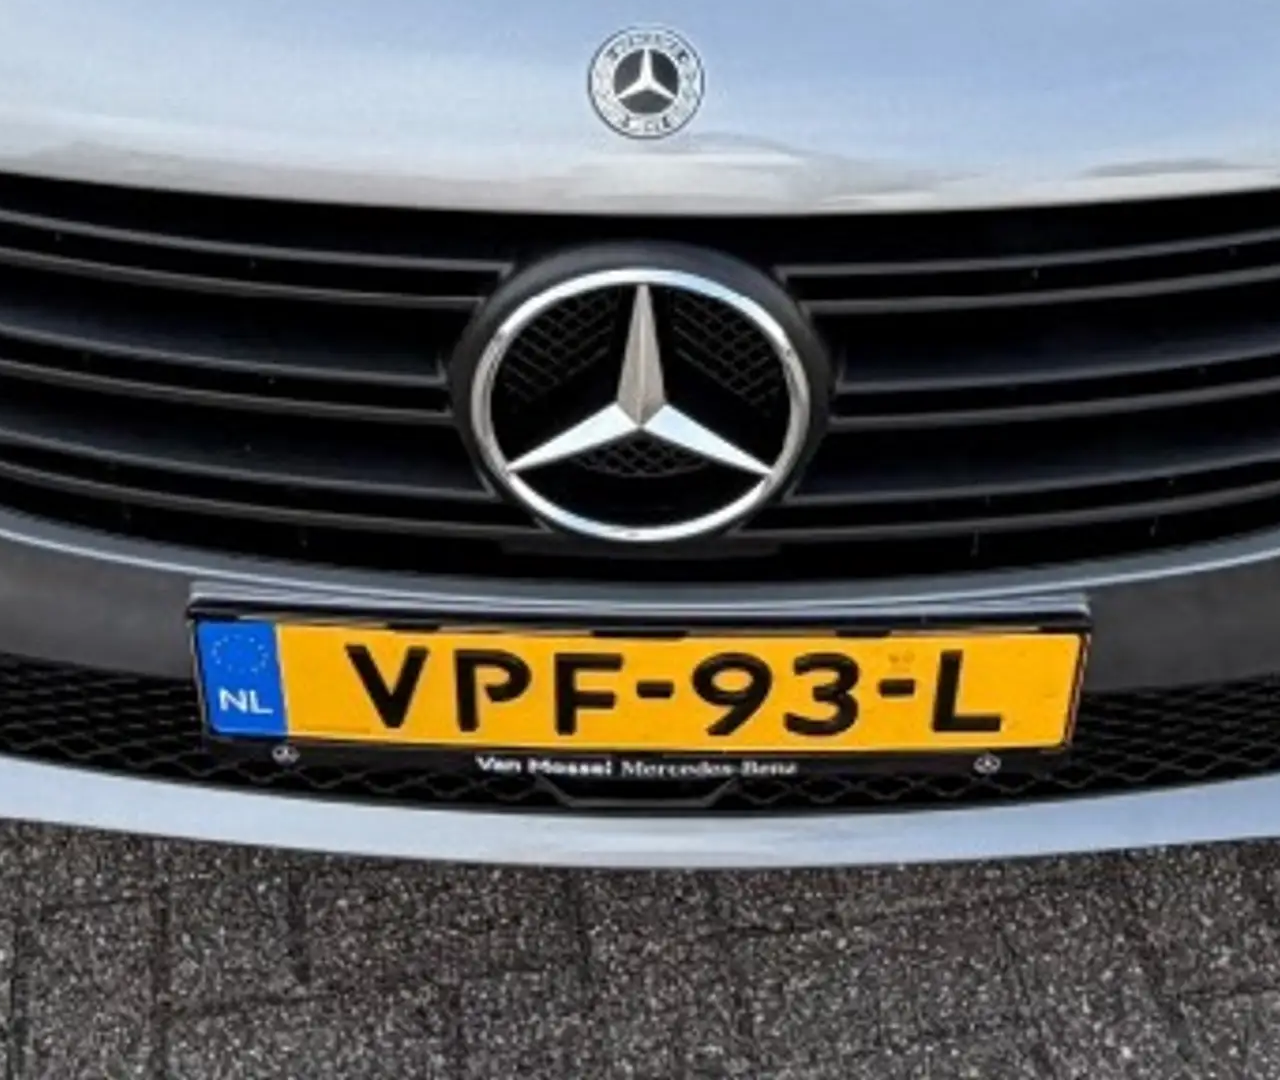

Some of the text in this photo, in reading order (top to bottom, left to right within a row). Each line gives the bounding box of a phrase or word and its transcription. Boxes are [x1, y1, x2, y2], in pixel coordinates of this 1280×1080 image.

[218, 687, 274, 715] NL
[345, 644, 1003, 736] VPF-93-L
[475, 755, 521, 773] Van
